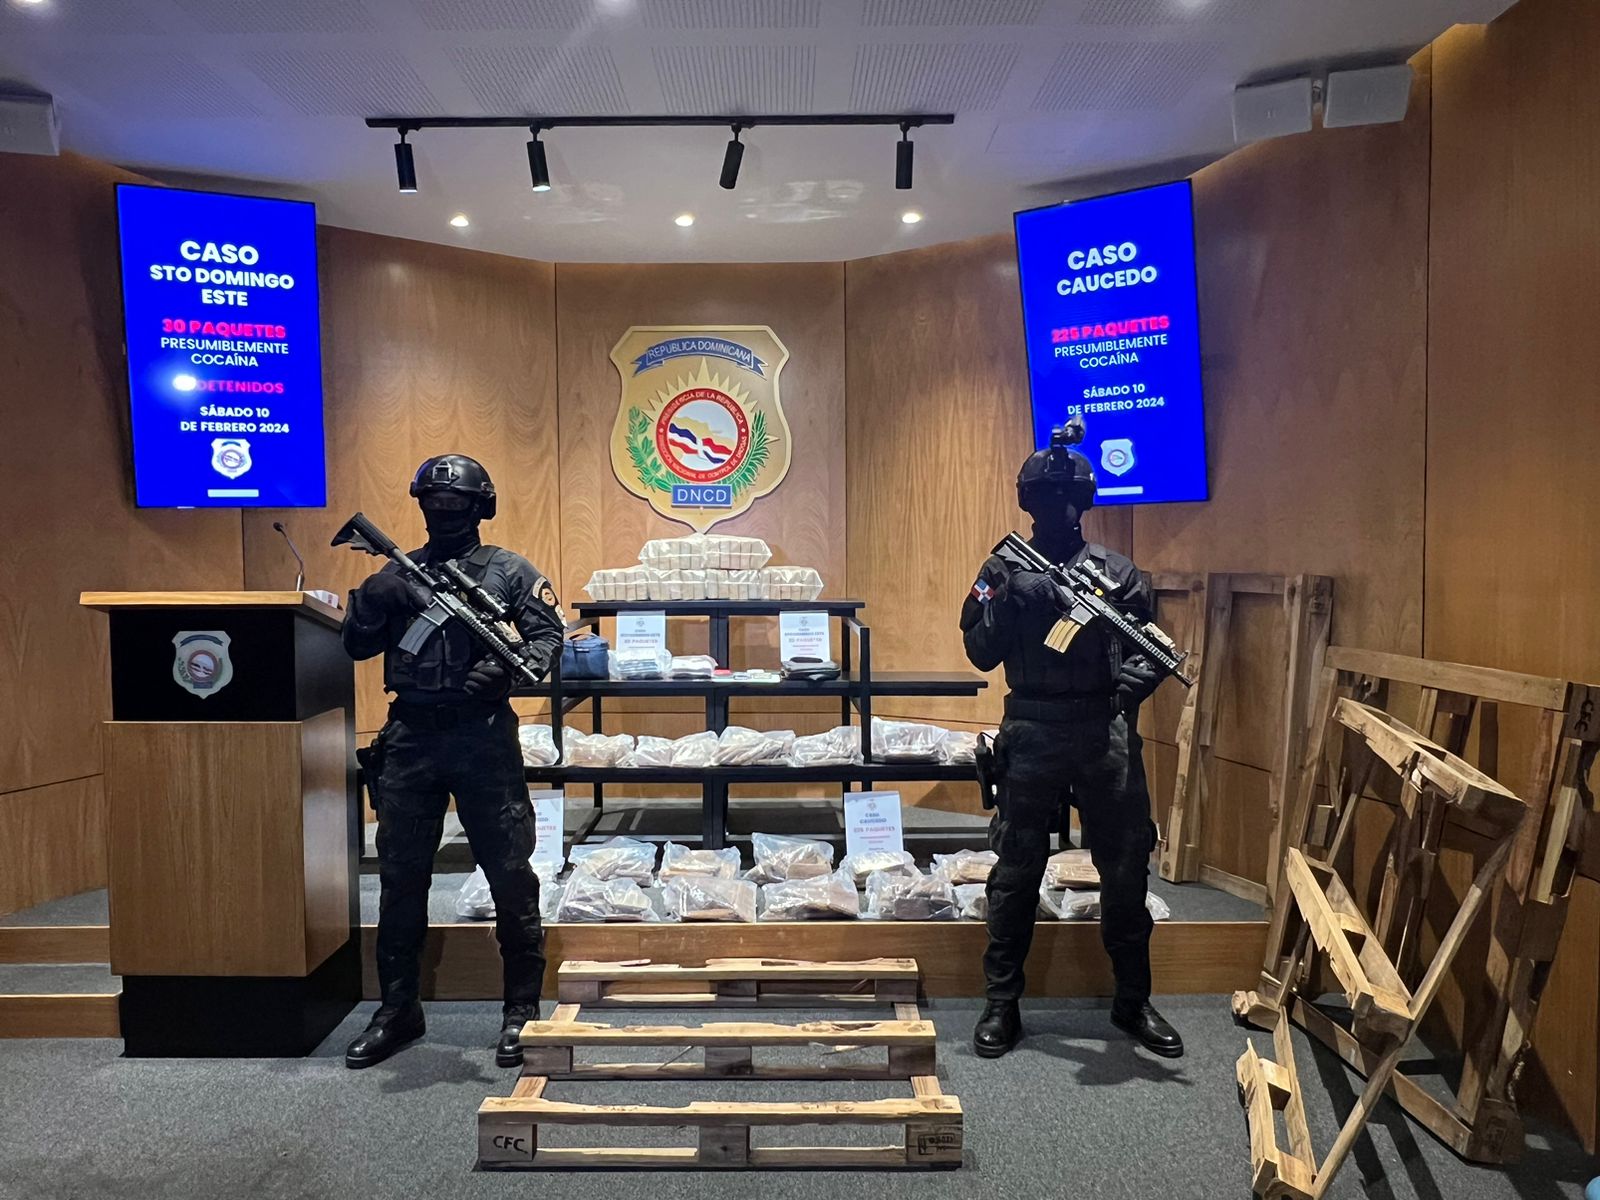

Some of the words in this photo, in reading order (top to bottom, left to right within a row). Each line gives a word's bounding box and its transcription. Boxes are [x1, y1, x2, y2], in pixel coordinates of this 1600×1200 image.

[180, 240, 259, 265] CASO
[1067, 241, 1137, 270] CASO
[149, 265, 192, 282] STO
[195, 267, 295, 289] DOMINGO
[1056, 265, 1158, 296] CAUCEDO
[201, 288, 248, 306] ESTE
[162, 318, 186, 333] 30
[189, 320, 287, 339] PAQUETES
[1052, 326, 1080, 343] 225
[1081, 315, 1170, 339] PAQUETES
[160, 337, 289, 354] PRESUMIBLEMENTE
[698, 339, 751, 364] DOMINICANA
[1054, 334, 1169, 358] PRESUMIBLEMENTE
[190, 352, 259, 367] COCAÍNA
[1079, 351, 1139, 369] COCAÍNA
[198, 379, 285, 394] DETENIDOS
[1083, 384, 1131, 399] SÁBADO
[1132, 383, 1146, 394] 10
[199, 404, 254, 418] SÁBADO
[255, 407, 270, 418] 10
[1067, 404, 1083, 416] DE
[1084, 399, 1135, 414] FEBRERO
[1136, 396, 1165, 410] 2024
[180, 421, 198, 432] DE
[200, 421, 257, 433] FEBRERO
[259, 422, 290, 434] 2024
[677, 488, 727, 502] DNCD
[493, 1135, 528, 1154] CFC
